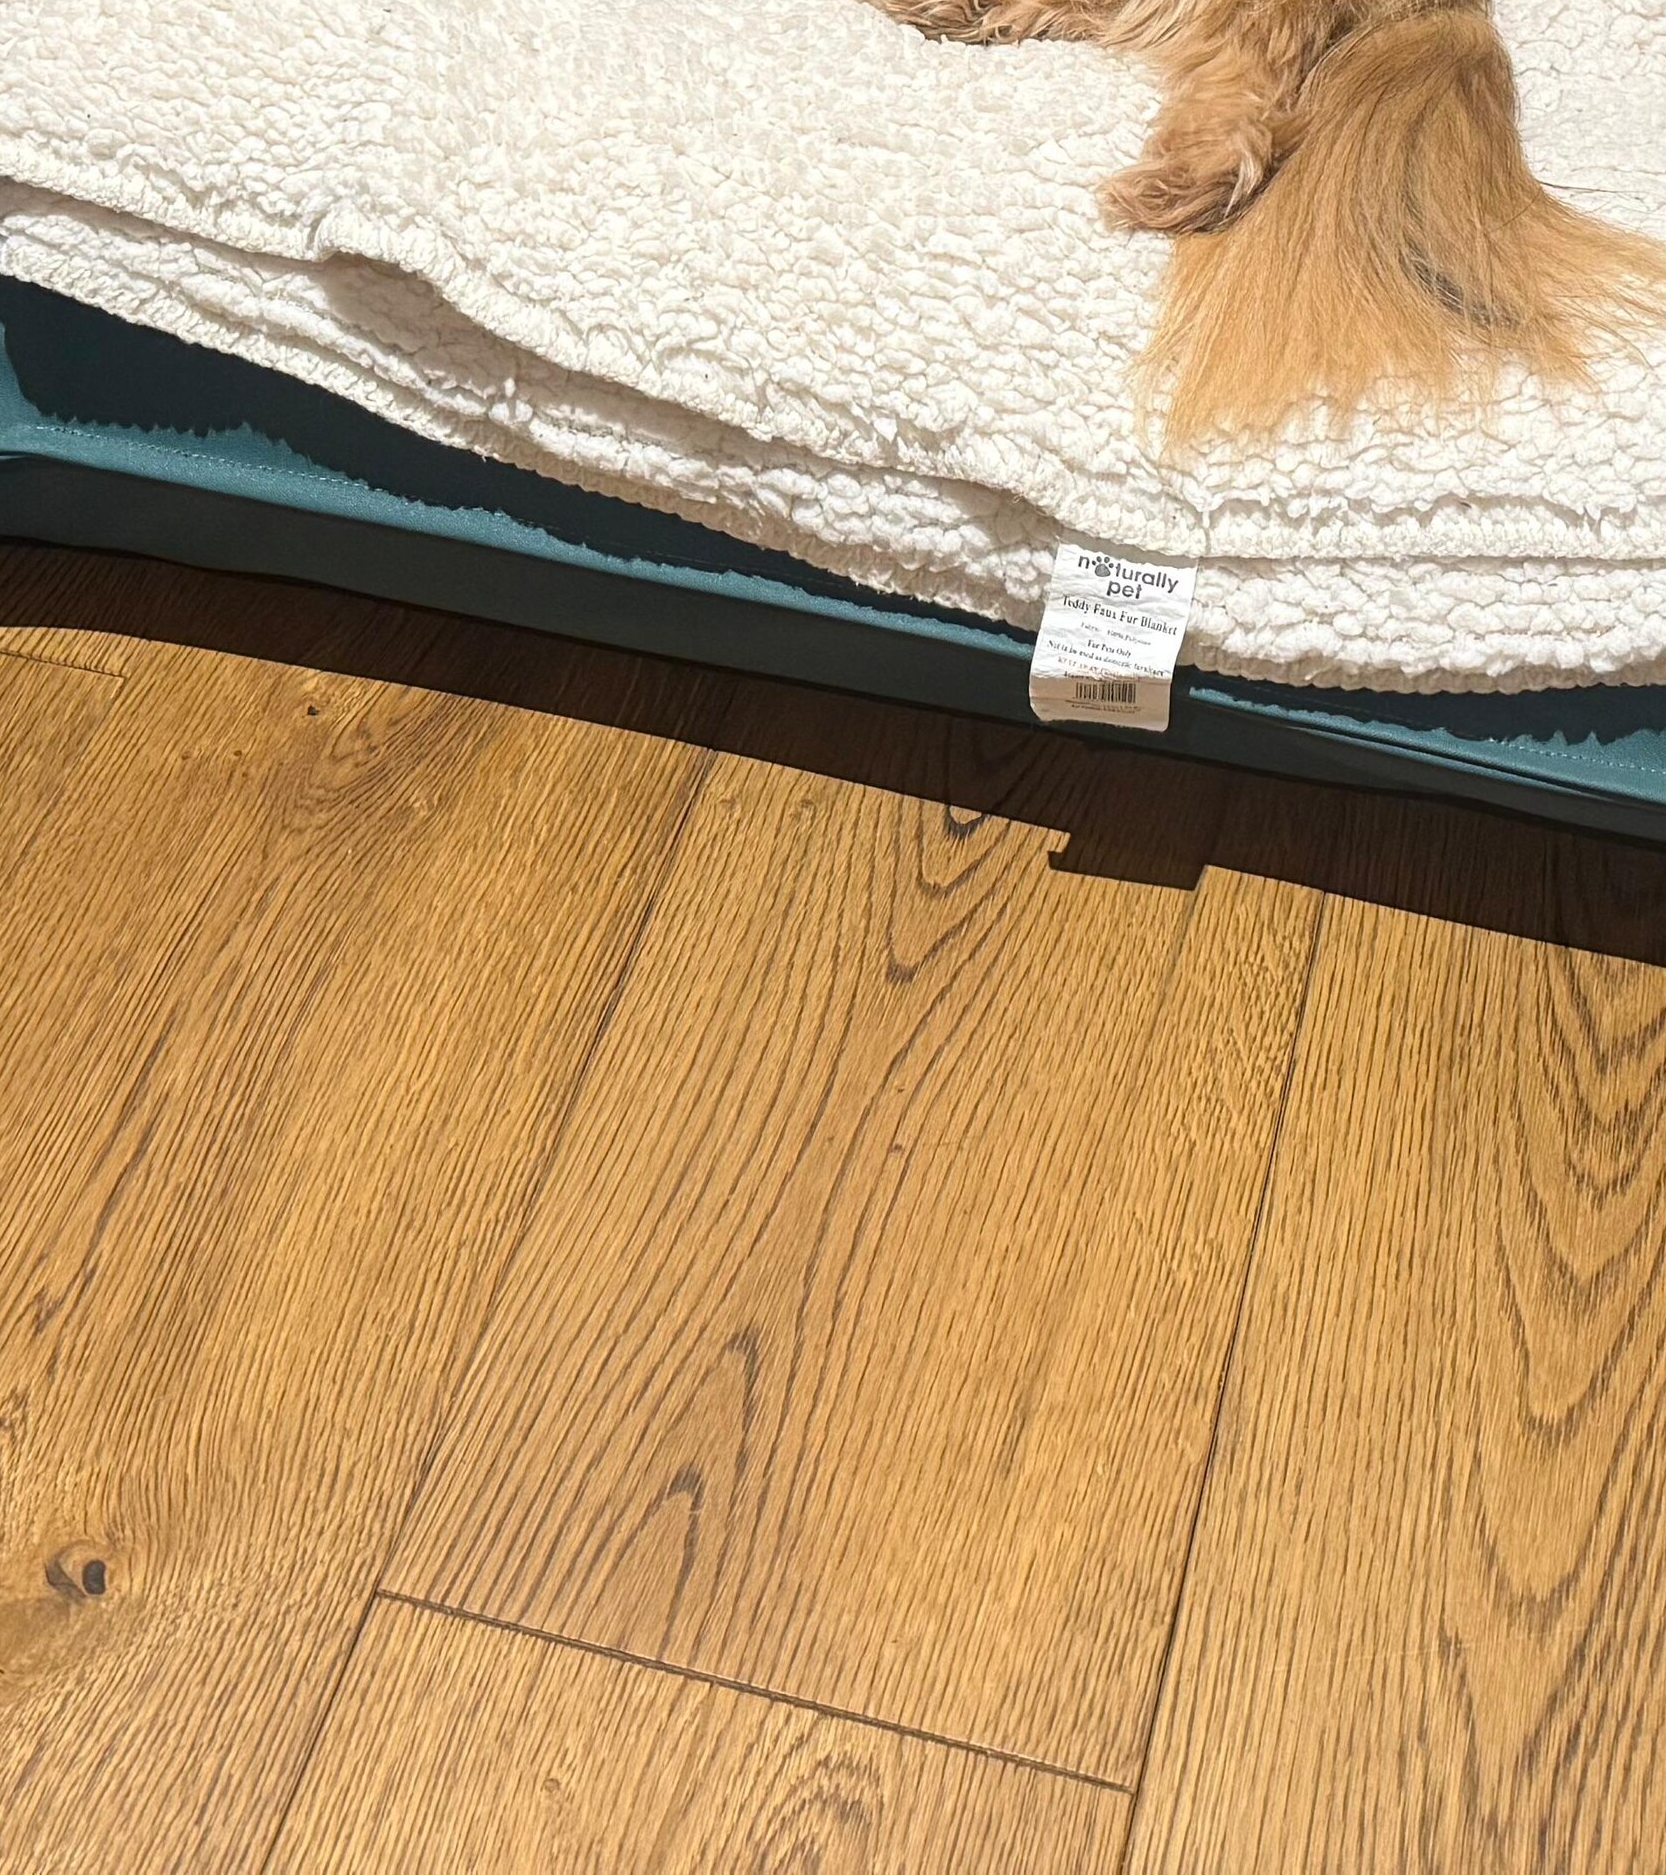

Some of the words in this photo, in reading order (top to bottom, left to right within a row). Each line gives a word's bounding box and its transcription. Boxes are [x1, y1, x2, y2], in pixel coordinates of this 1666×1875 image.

[1106, 580, 1143, 600] pet
[1063, 595, 1091, 615] Teddy
[1093, 603, 1117, 620] Faux
[1119, 609, 1139, 625] Fur
[1141, 616, 1178, 636] Blanket
